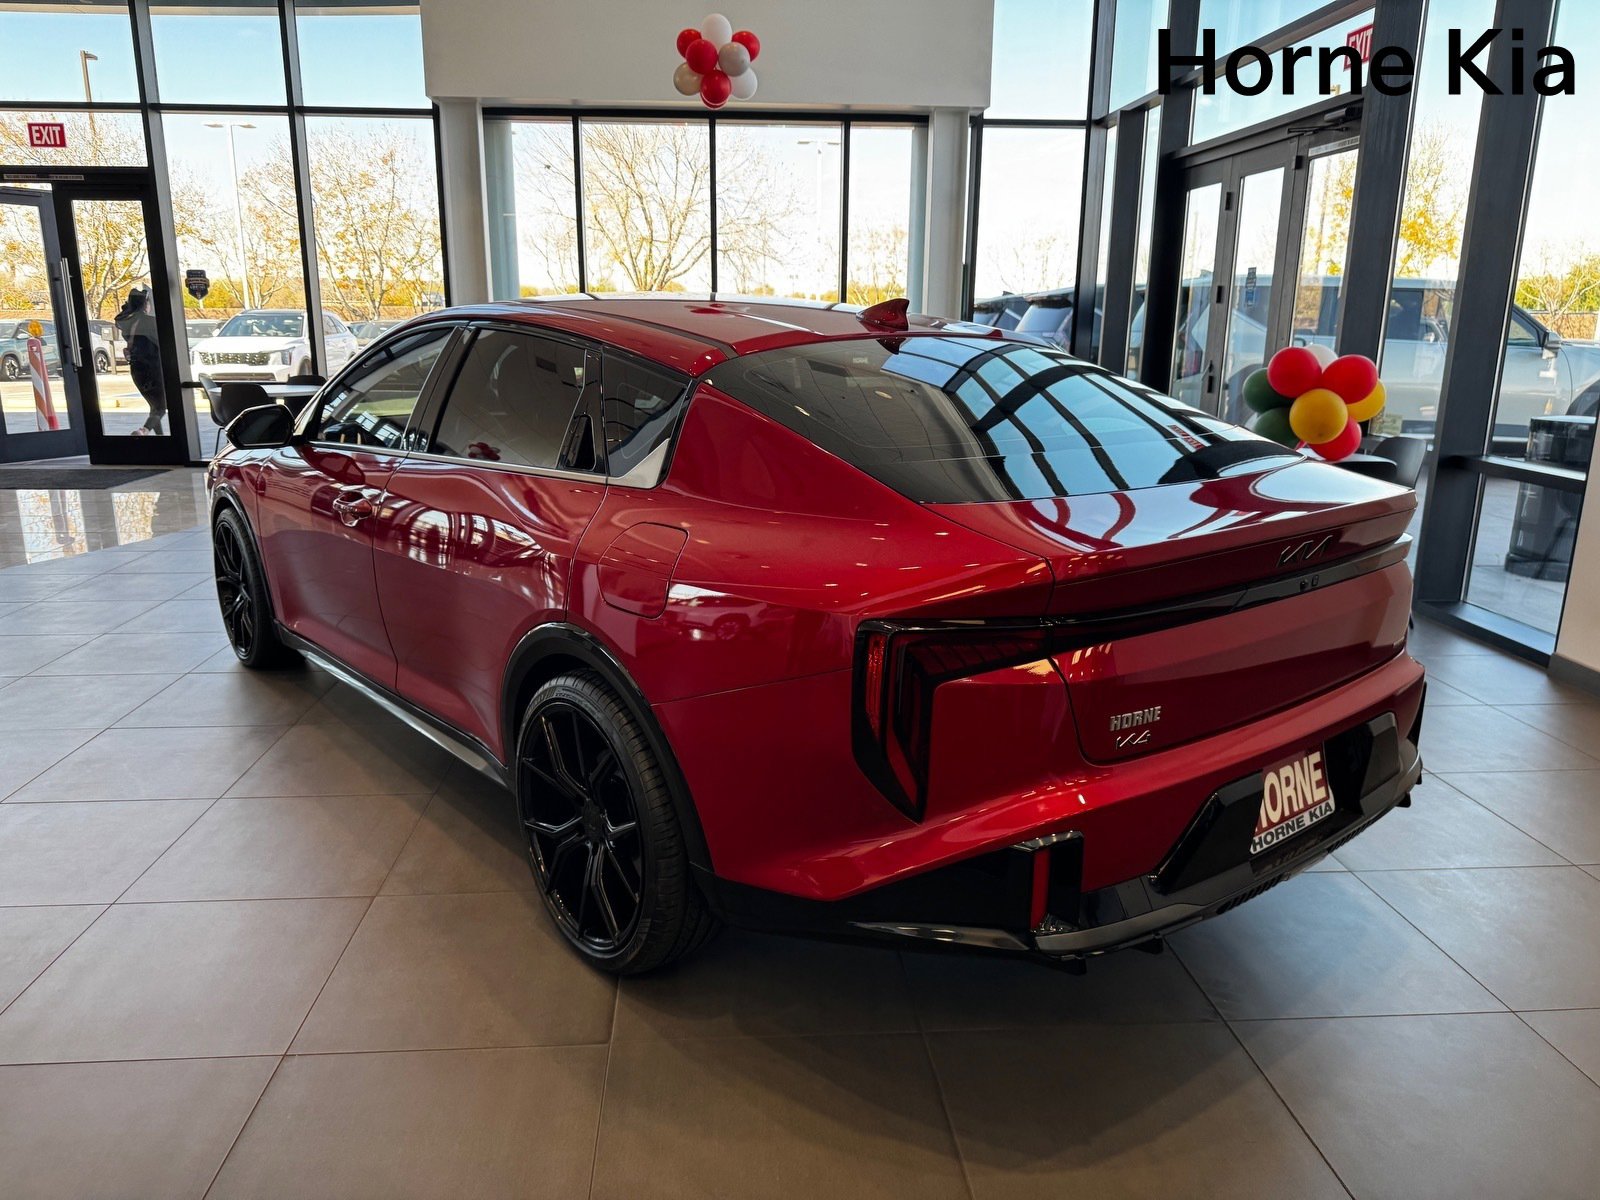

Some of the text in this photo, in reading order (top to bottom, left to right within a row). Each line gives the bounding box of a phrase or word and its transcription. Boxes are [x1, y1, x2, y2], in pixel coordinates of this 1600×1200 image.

[31, 126, 61, 145] EXIT
[1110, 705, 1161, 731] HORNE
[1252, 801, 1333, 852] HORNE KIA
